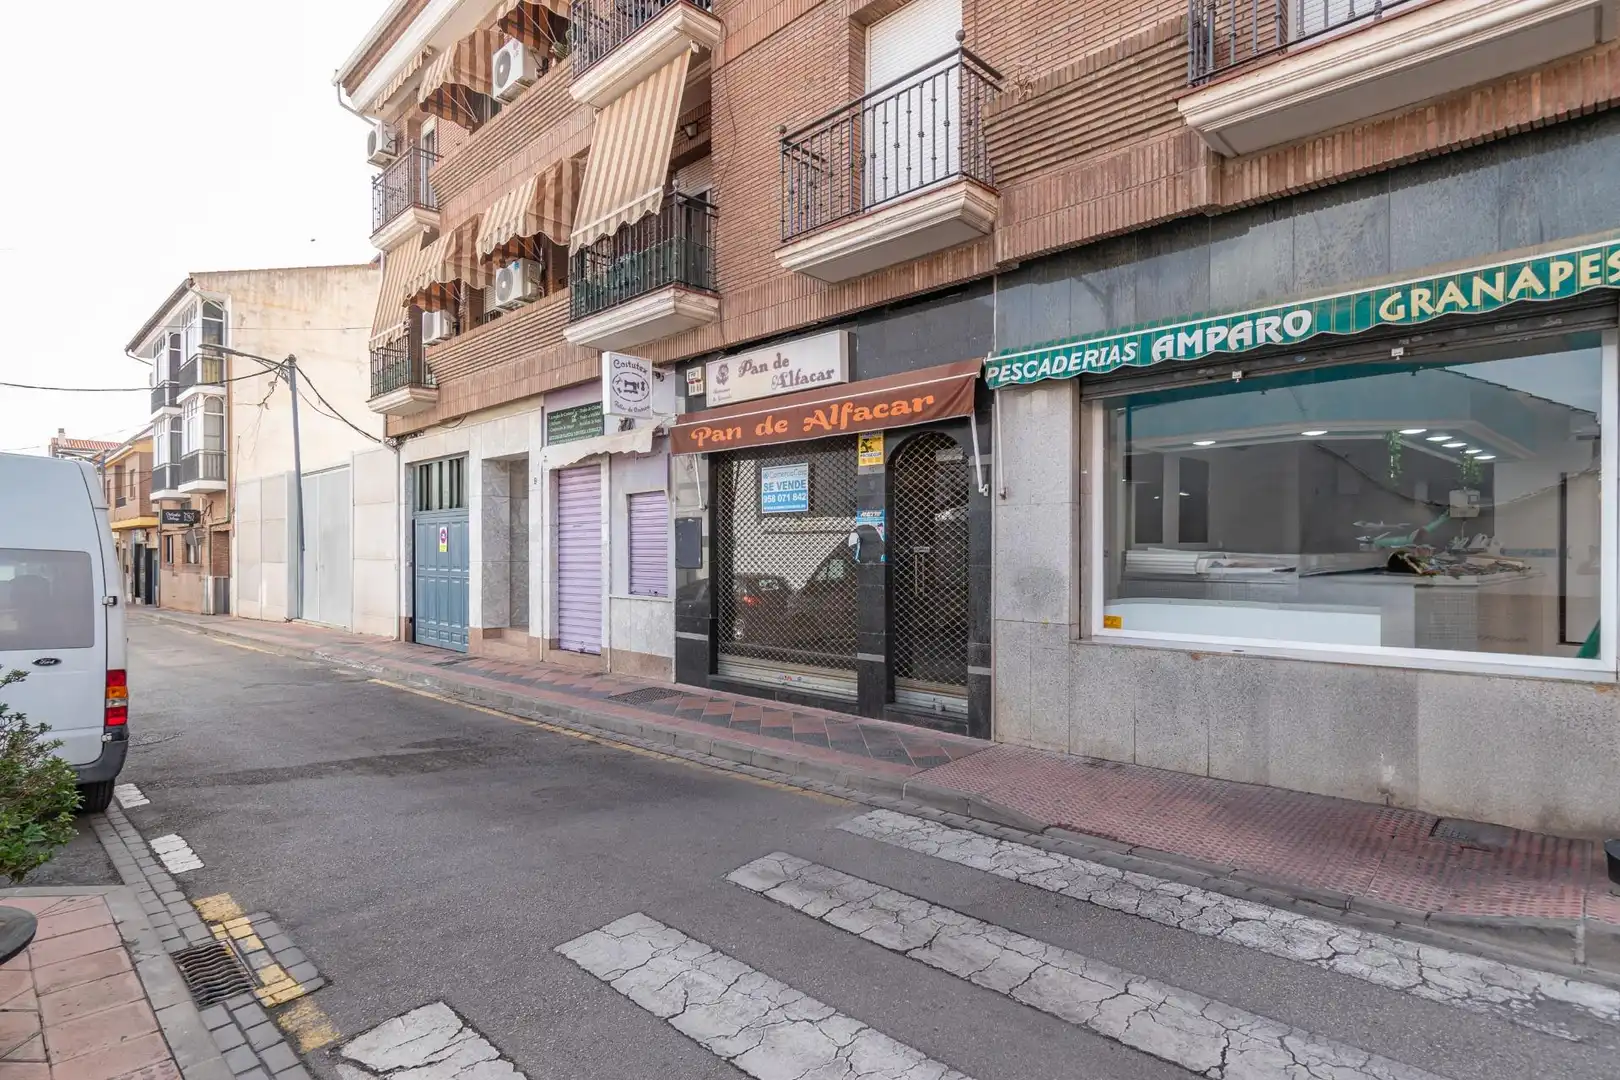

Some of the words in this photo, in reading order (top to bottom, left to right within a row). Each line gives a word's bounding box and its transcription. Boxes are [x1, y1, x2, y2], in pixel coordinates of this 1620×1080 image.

[986, 342, 1138, 384] PESCADERIAS
[1151, 309, 1312, 360] AMPARO
[738, 358, 768, 378] Pan
[773, 352, 789, 369] de
[771, 367, 835, 390] Alfacar
[691, 425, 742, 447] Pan
[755, 415, 788, 437] de
[803, 394, 936, 432] Alfacar
[764, 482, 774, 492] SE
[777, 479, 806, 490] VENDE
[764, 494, 776, 503] 958
[777, 493, 790, 502] 071
[792, 492, 806, 501] 842
